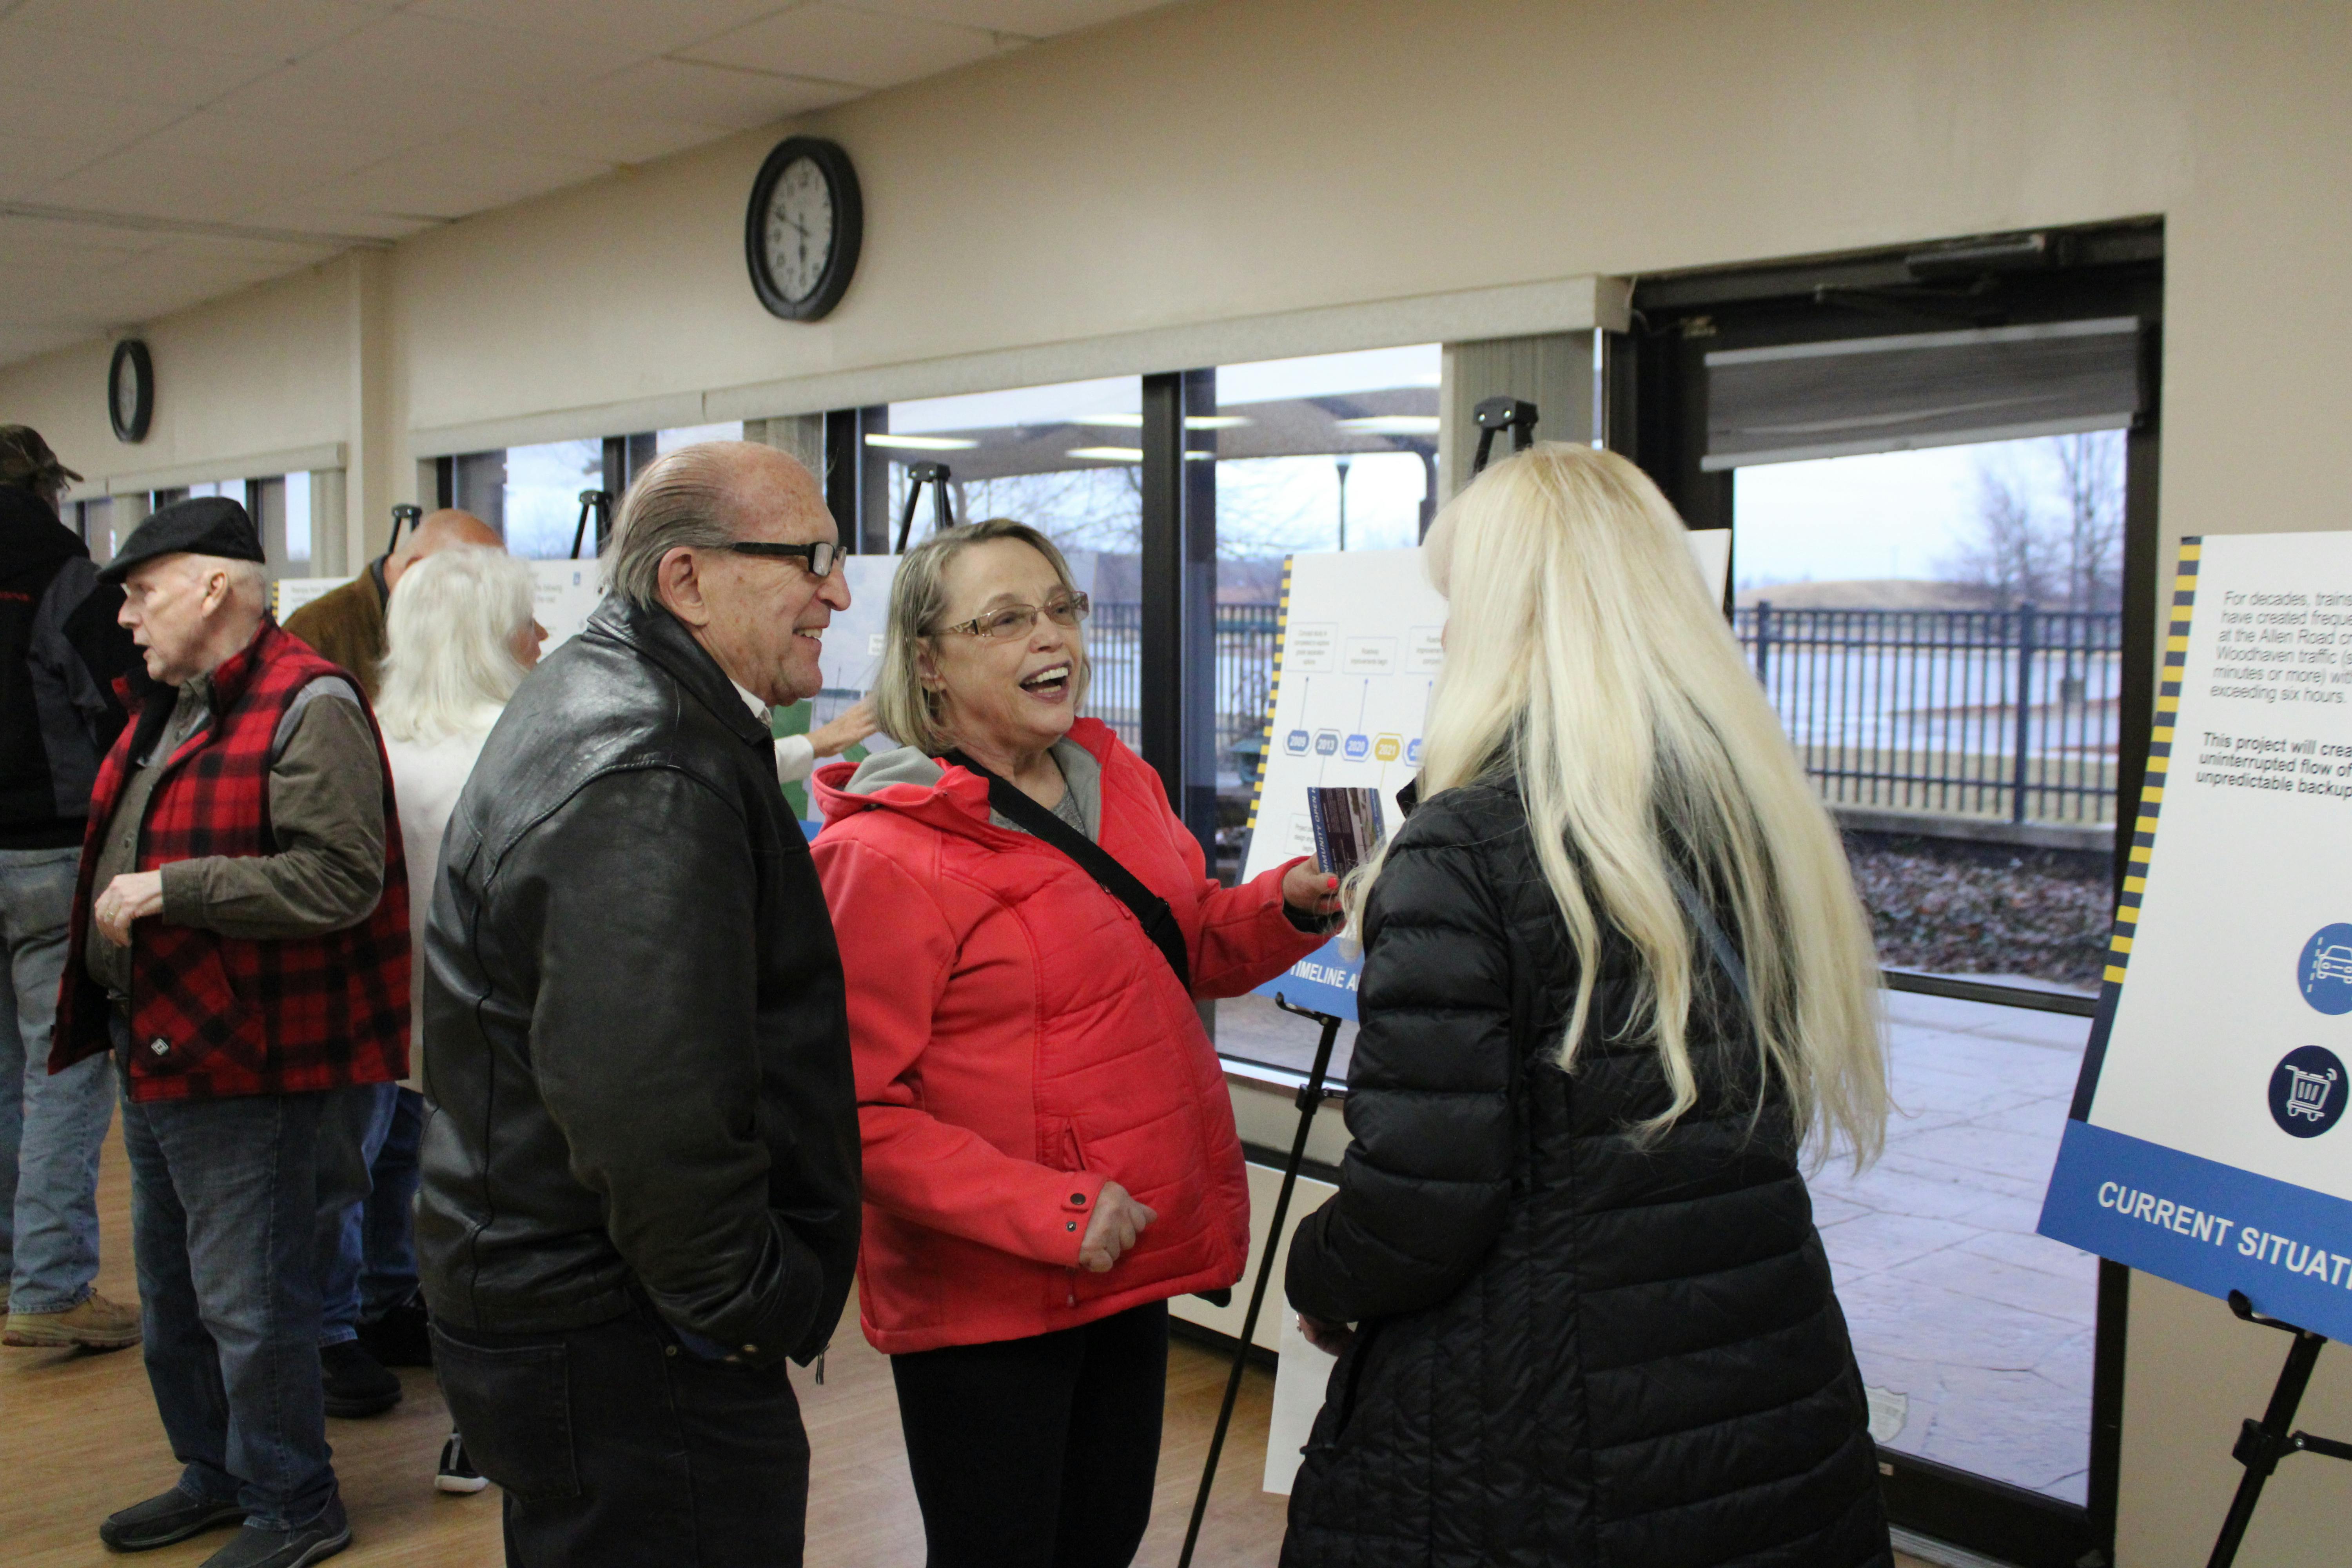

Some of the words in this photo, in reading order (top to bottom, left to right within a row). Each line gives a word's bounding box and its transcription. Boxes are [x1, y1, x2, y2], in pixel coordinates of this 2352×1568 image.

[2223, 591, 2247, 606] For
[2249, 591, 2310, 607] decades,
[2221, 610, 2253, 624] have
[2256, 610, 2308, 625] created
[2218, 629, 2232, 642] at
[2234, 628, 2255, 642] the
[2258, 628, 2293, 643] Allen
[2297, 629, 2336, 645] Road
[2216, 646, 2294, 662] Woodhaven
[2298, 648, 2336, 664] traffic
[2212, 665, 2264, 680] minutes
[2267, 669, 2283, 681] or
[2285, 668, 2326, 686] more)
[2210, 684, 2277, 703] exceeding
[2280, 686, 2300, 701] six
[2303, 688, 2347, 704] hours.
[1348, 740, 1365, 752] 2020
[1378, 744, 1396, 755] 2021
[2203, 731, 2232, 748] This
[2235, 737, 2287, 755] project
[2291, 740, 2317, 755] will
[2199, 751, 2296, 773] uninterrupted
[2300, 759, 2333, 776] flow
[2336, 762, 2352, 777] of
[2196, 771, 2293, 791] unpredictable
[2297, 778, 2352, 801] backup
[1311, 795, 1321, 822] OPEN
[2098, 1181, 2234, 1246] CURRENT
